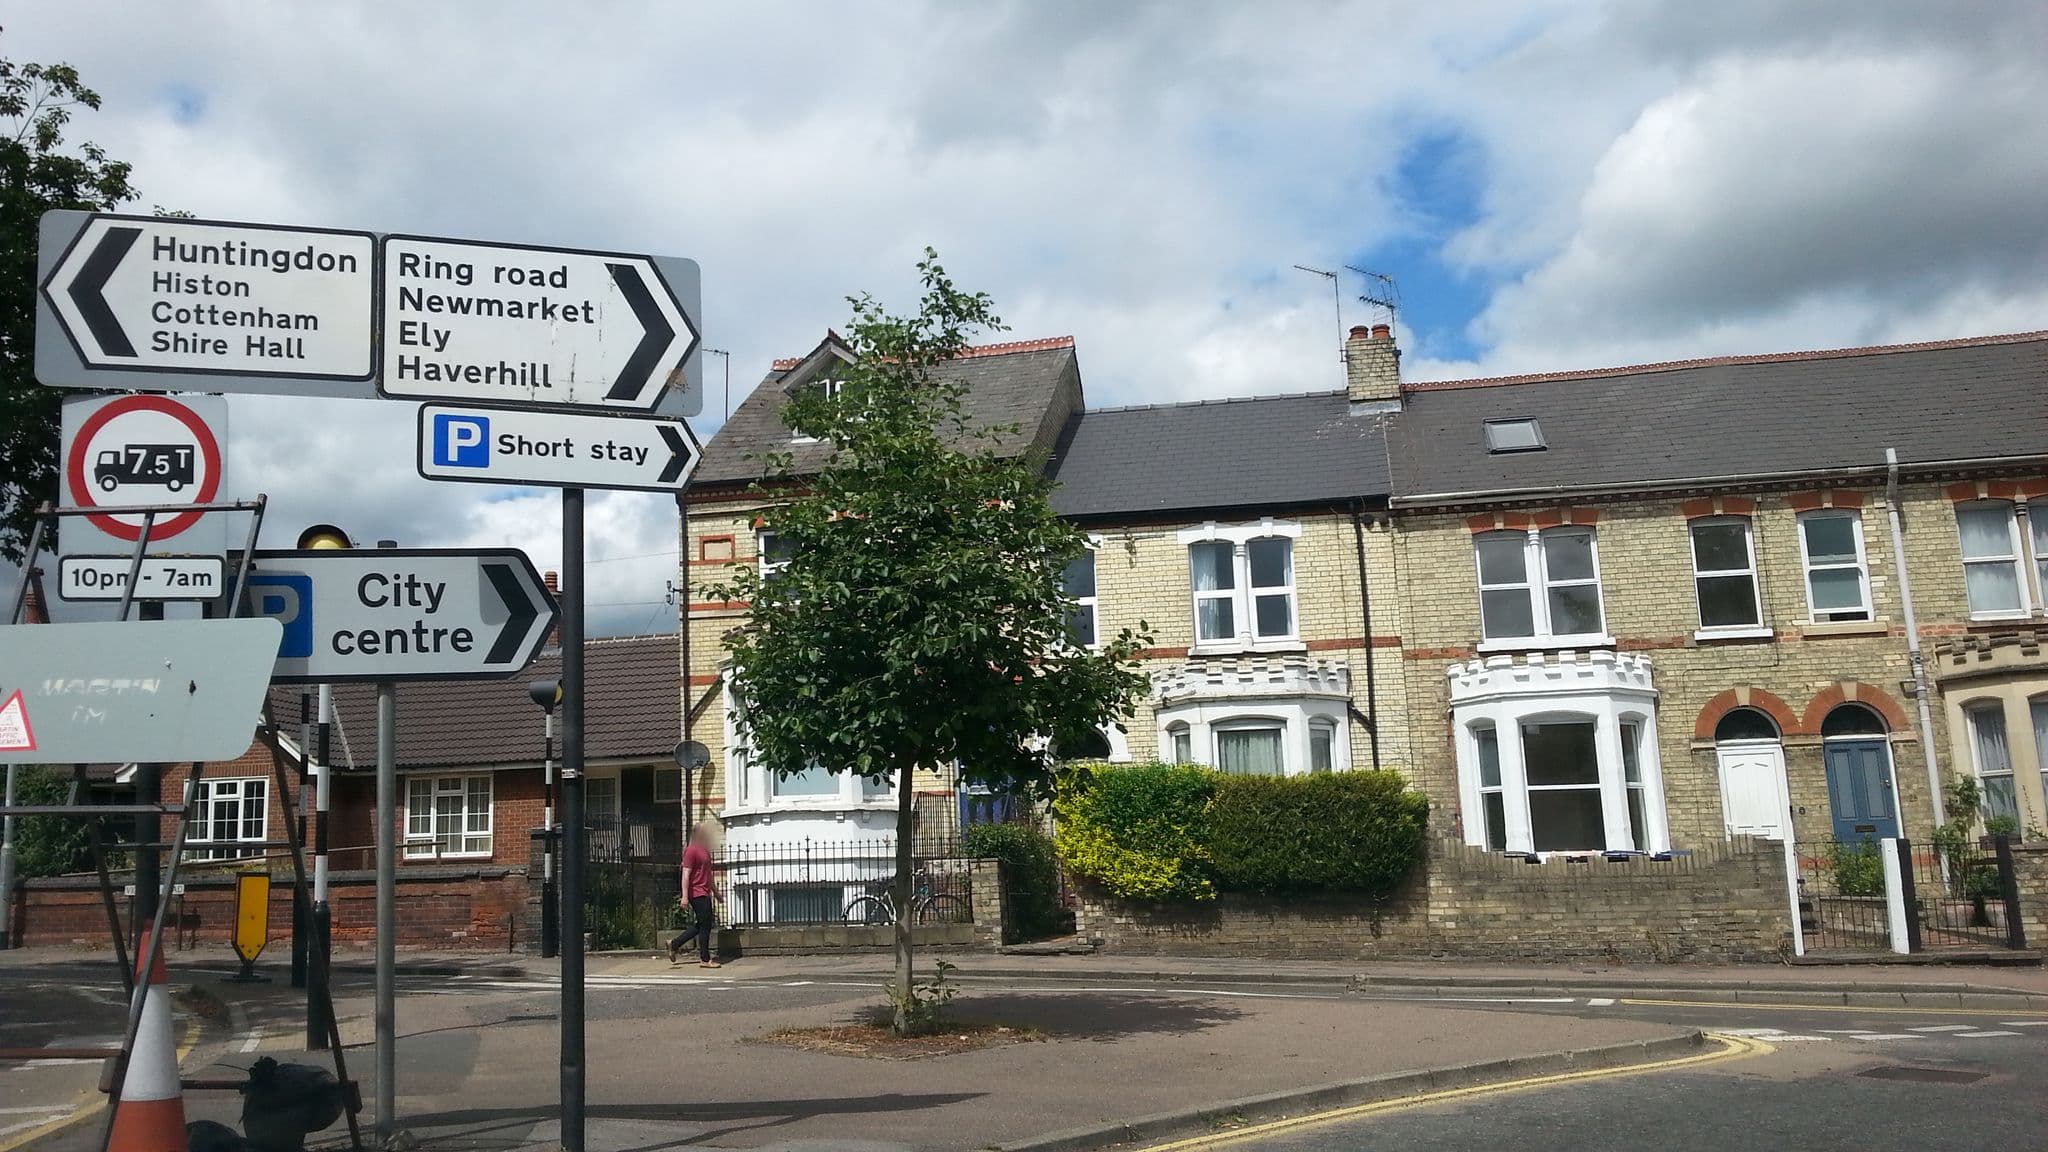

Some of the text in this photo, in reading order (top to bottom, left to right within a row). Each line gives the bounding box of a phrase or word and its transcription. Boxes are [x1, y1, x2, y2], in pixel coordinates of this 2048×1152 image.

[153, 236, 356, 273] Huntingdon
[400, 253, 567, 288] Ring road
[153, 271, 249, 297] Histon
[152, 301, 317, 330] Cottenham
[400, 287, 594, 323] Newmarket
[152, 331, 304, 359] Shire Hall
[400, 321, 450, 352] Ely
[399, 355, 552, 388] Haverhill
[448, 420, 648, 465] P Short stay
[163, 569, 211, 586] 7am
[358, 573, 446, 613] City
[332, 620, 473, 655] centre
